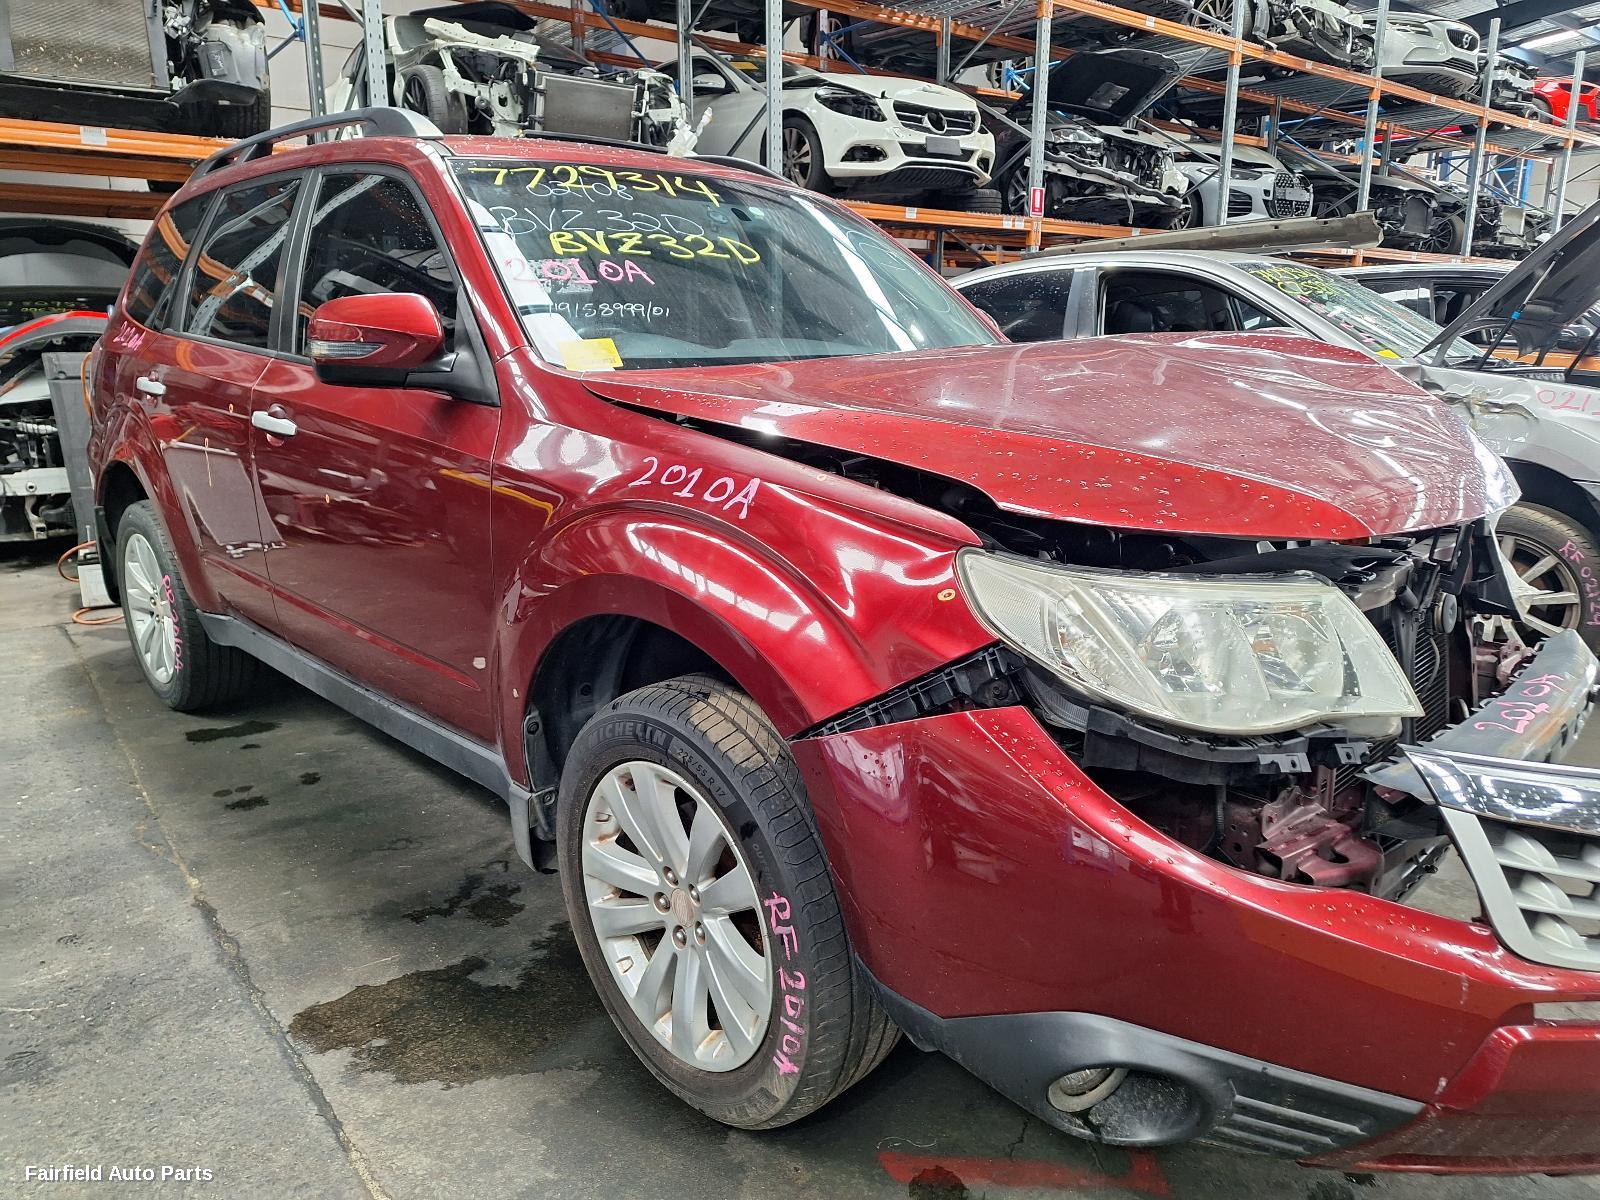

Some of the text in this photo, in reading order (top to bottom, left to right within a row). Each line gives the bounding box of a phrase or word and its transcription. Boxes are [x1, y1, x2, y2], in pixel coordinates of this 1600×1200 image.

[467, 165, 720, 207] 7729314
[549, 230, 761, 265] BVZ32D
[627, 456, 761, 520] 2010A
[587, 720, 668, 748] MICHELIN
[764, 891, 807, 1077] RF 2010A
